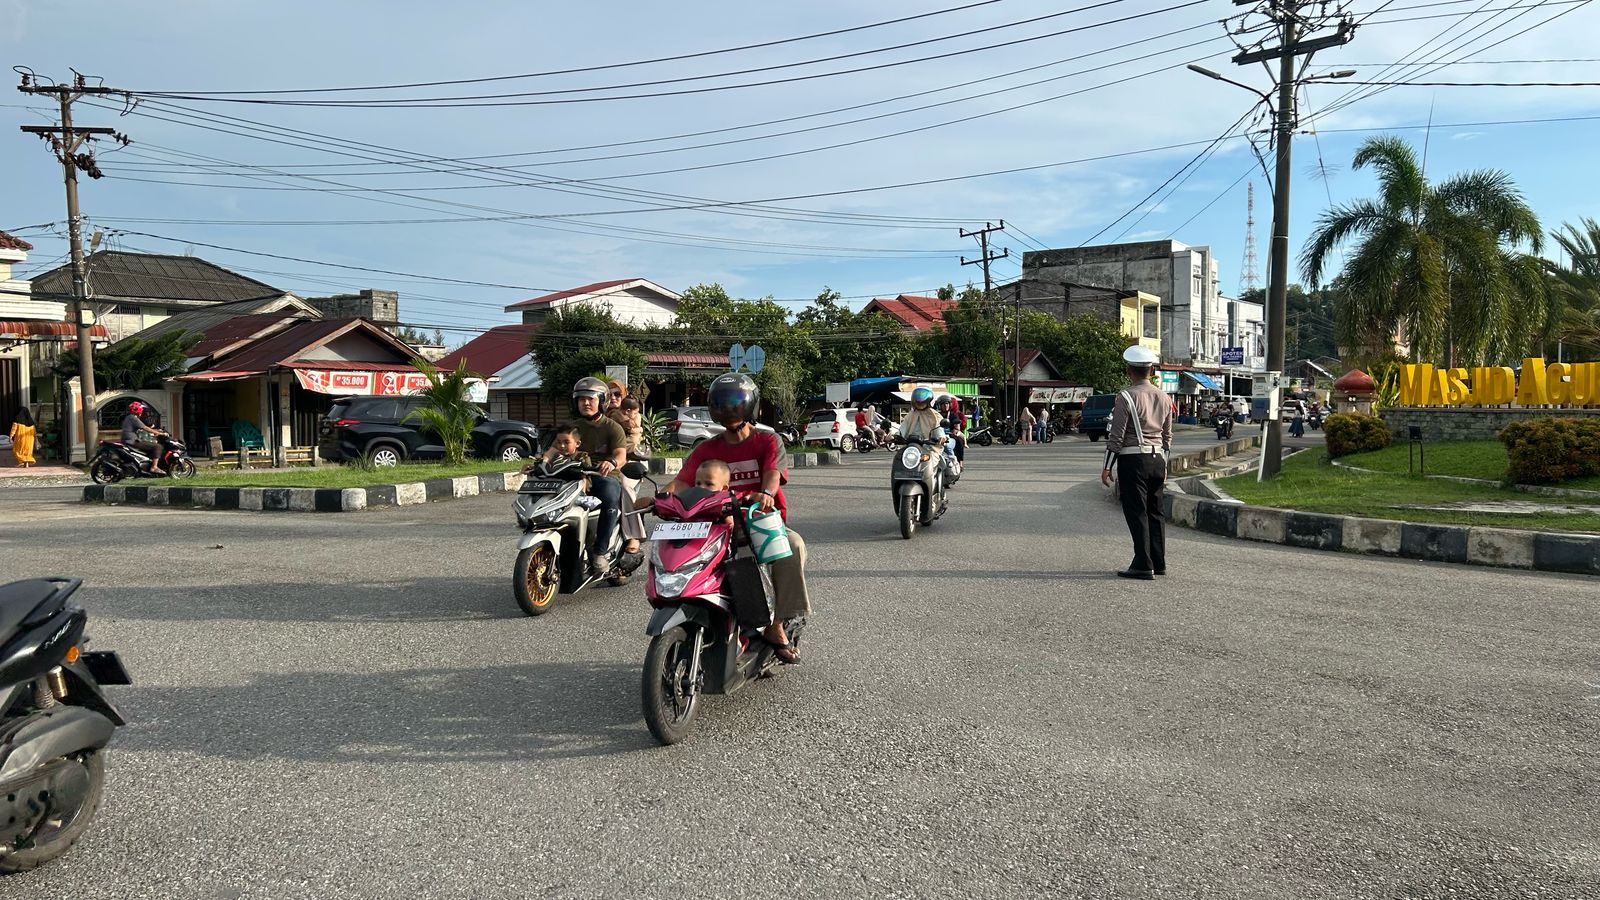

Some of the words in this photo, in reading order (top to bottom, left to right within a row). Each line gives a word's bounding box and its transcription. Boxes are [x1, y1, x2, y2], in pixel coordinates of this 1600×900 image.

[341, 376, 364, 385] 35.000
[1400, 363, 1514, 405] MASJID
[670, 523, 693, 531] 4680
[698, 522, 710, 530] TW
